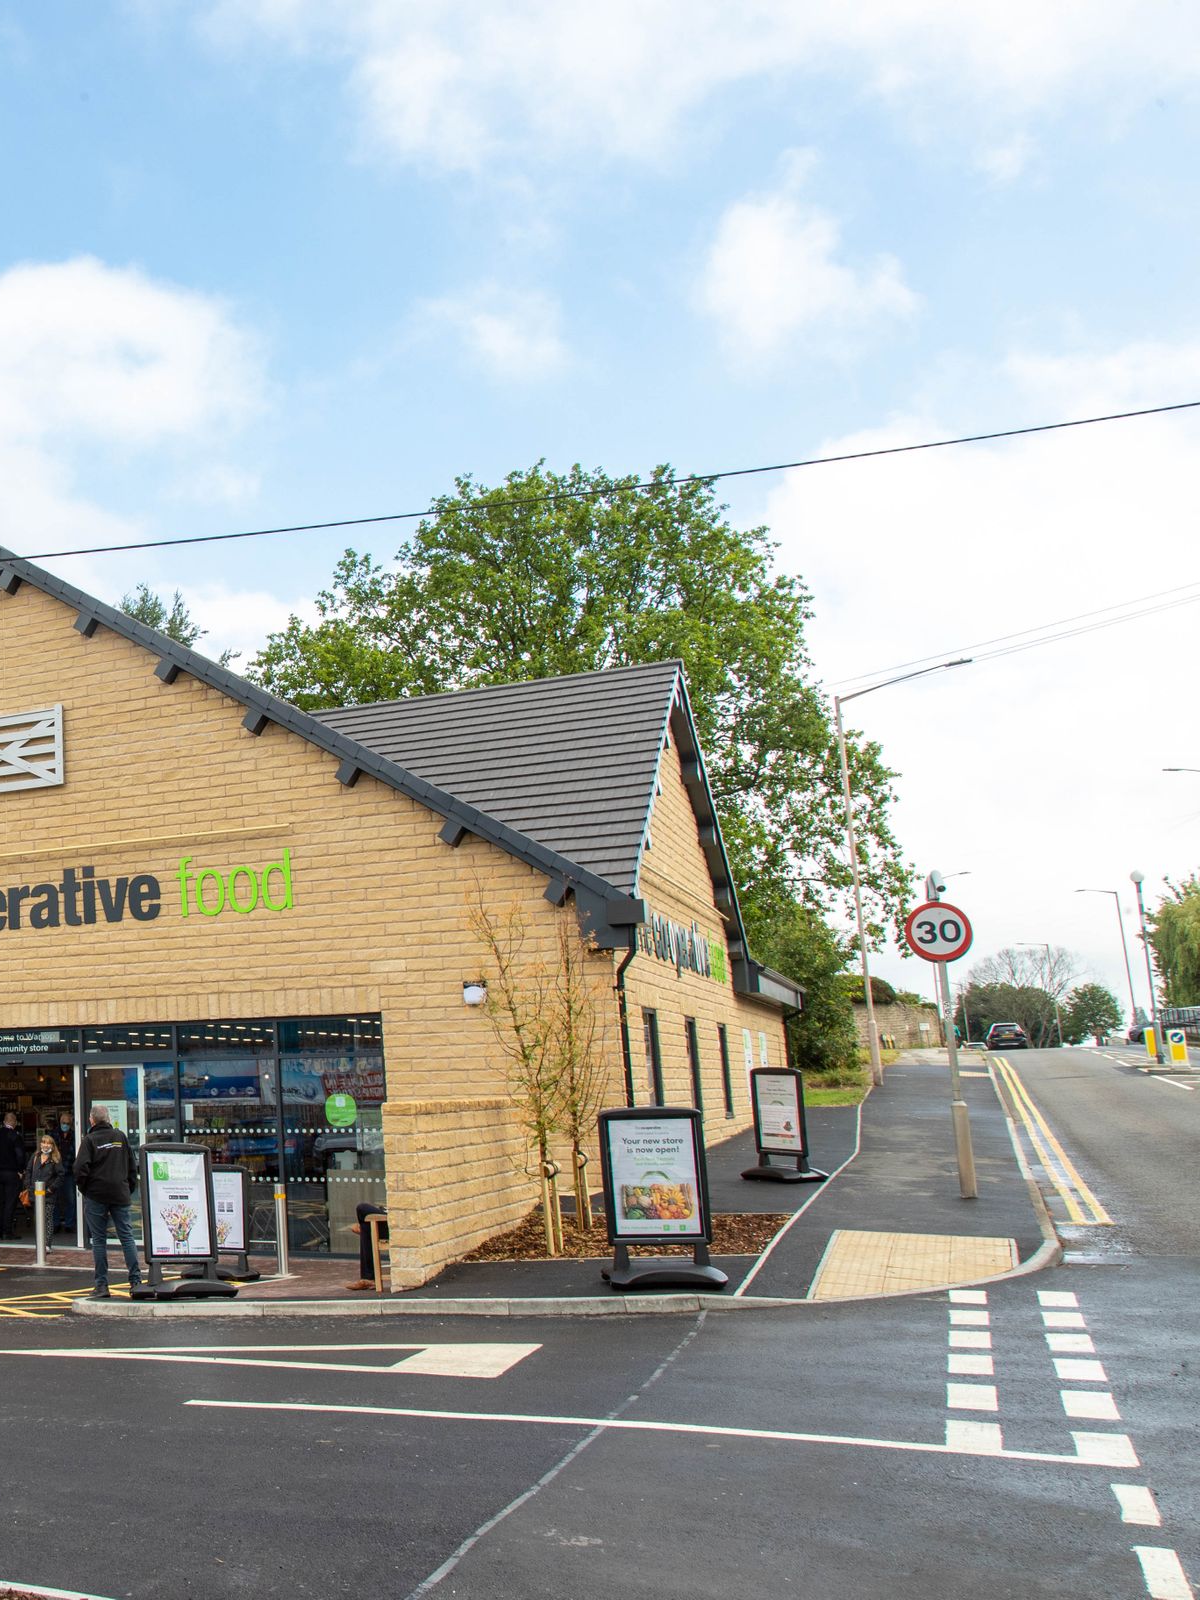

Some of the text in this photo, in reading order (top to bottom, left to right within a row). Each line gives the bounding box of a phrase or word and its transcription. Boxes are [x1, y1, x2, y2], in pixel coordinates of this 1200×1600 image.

[176, 848, 293, 918] food
[916, 919, 961, 944] 30
[16, 1033, 24, 1041] to
[29, 1044, 48, 1052] store
[655, 1146, 680, 1154] open!
